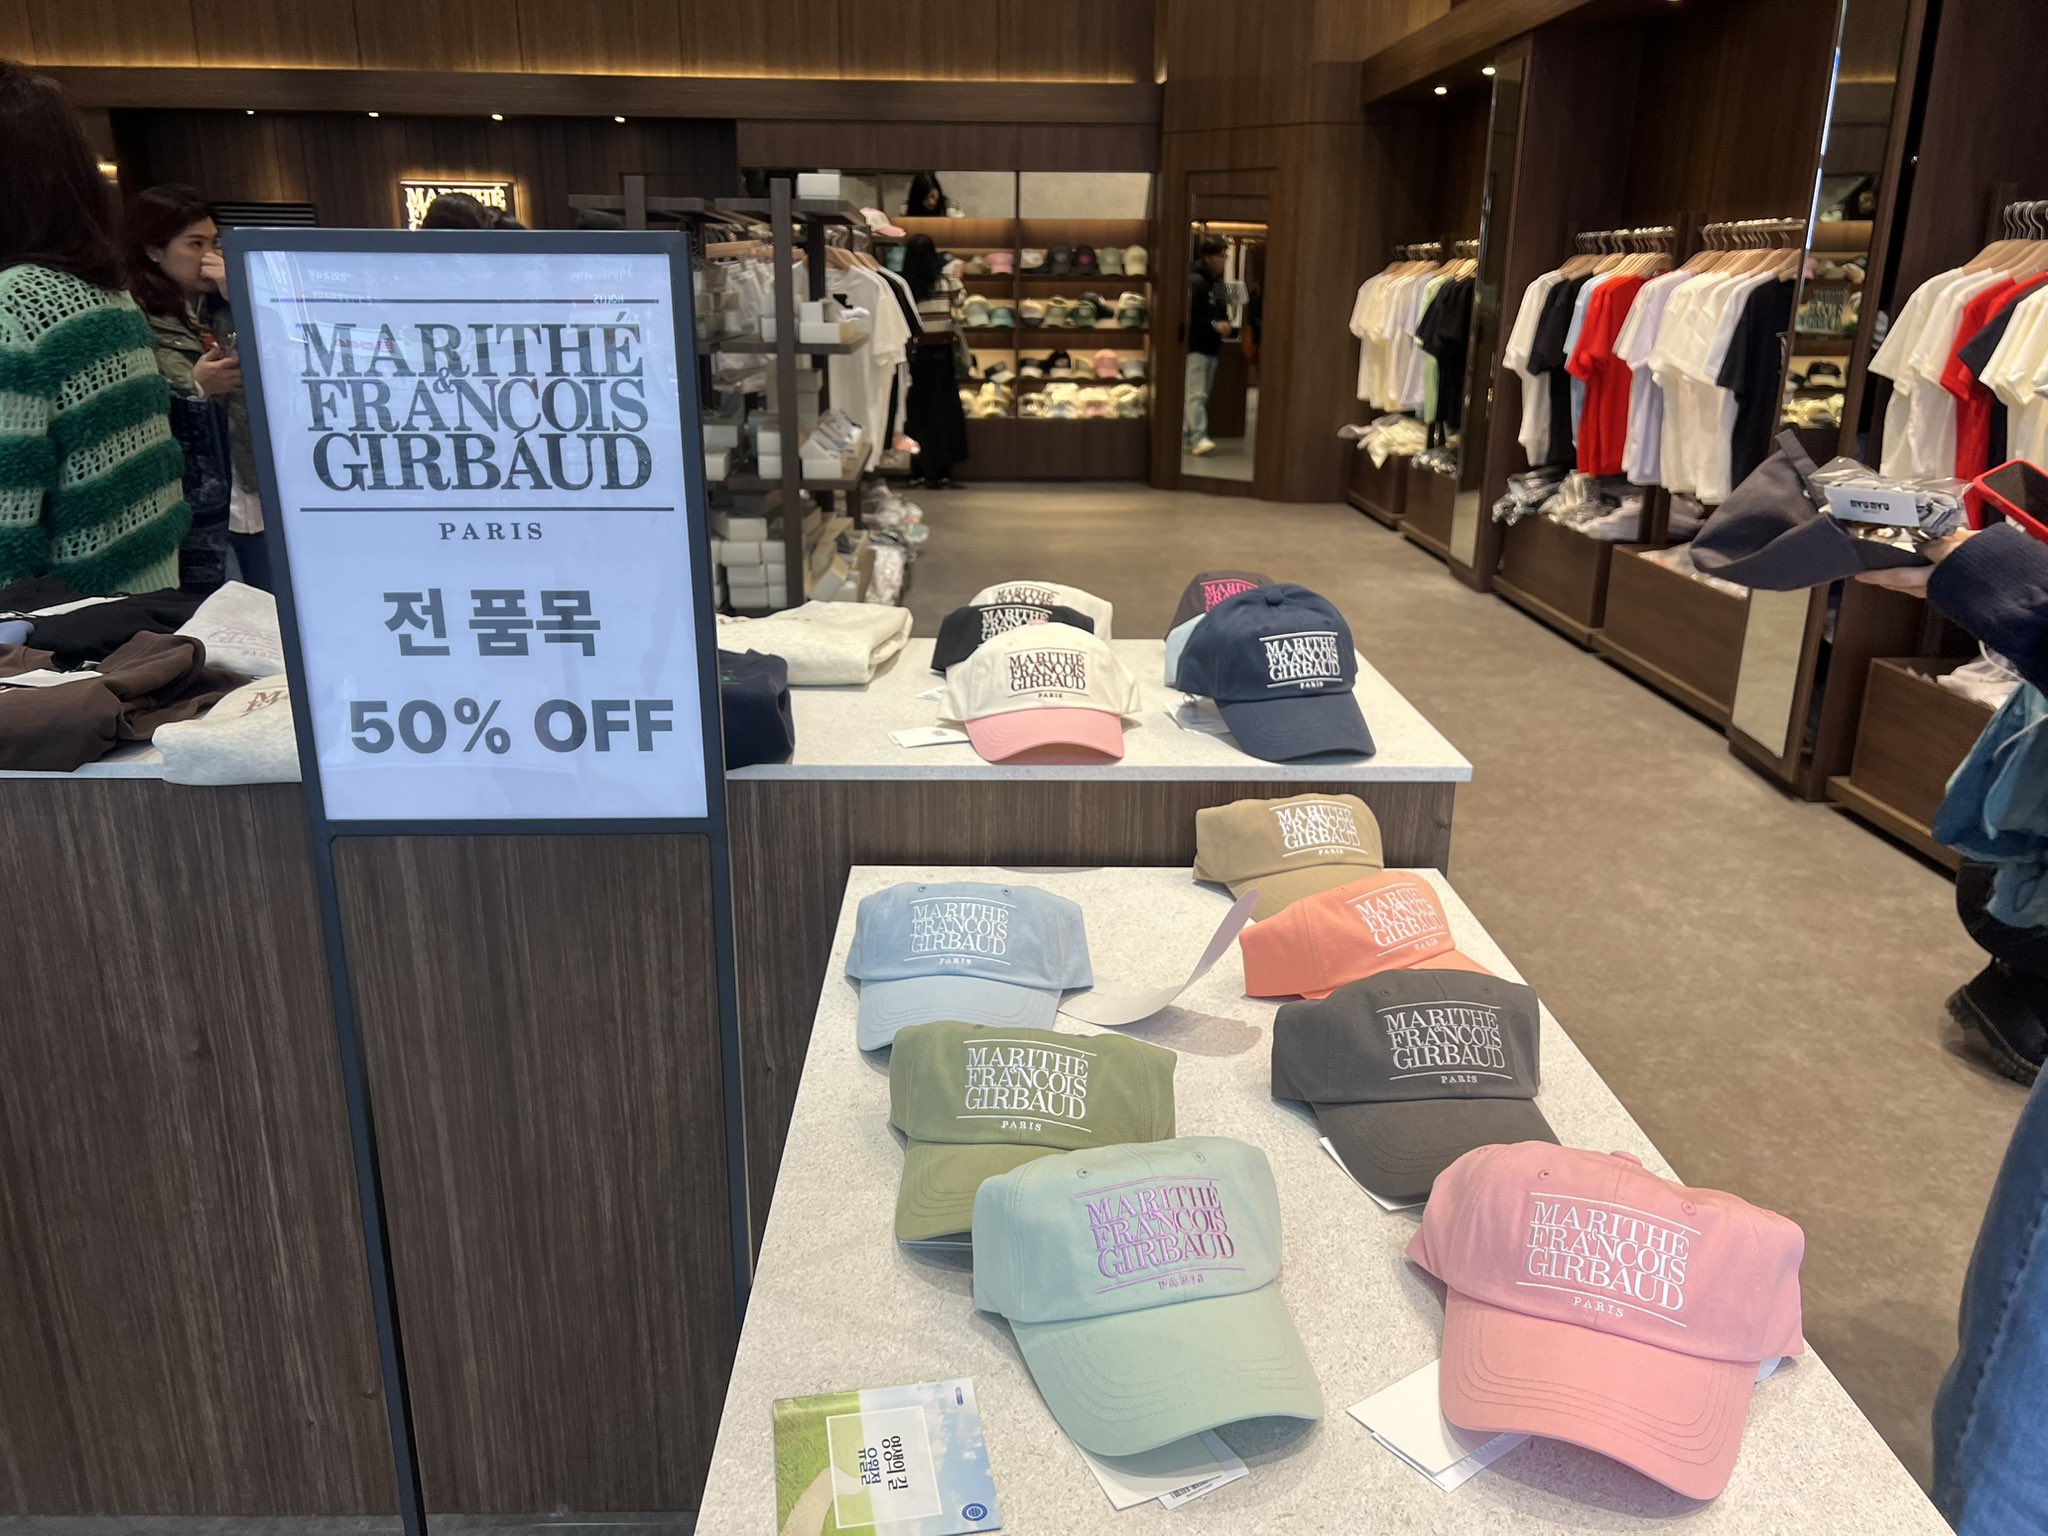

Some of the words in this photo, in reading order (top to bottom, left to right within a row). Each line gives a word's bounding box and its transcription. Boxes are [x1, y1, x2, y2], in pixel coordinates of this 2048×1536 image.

[296, 312, 643, 377] MARITHÉ
[312, 432, 652, 492] GIRBAUD
[438, 522, 544, 541] PARIS
[383, 588, 451, 657] 전
[468, 589, 601, 657] 품목
[1011, 674, 1086, 691] GIRBAUD
[1269, 661, 1340, 681] GIRBAUD
[349, 697, 511, 755] 50%
[534, 699, 674, 753] OFF
[911, 932, 1006, 955] GIRBAUD
[938, 957, 972, 965] PARIS
[966, 1047, 1089, 1079] MARITHÉ
[1392, 1044, 1506, 1070] GIRBAUD
[1440, 1075, 1478, 1084] PARIS
[964, 1087, 1087, 1120] GIRBAUD
[1001, 1120, 1042, 1132] PARIS
[1530, 1201, 1690, 1260] MARITHÉ
[1098, 1232, 1235, 1278] GIRBAUD
[1158, 1274, 1206, 1290] PARIS
[1527, 1248, 1684, 1311] GIRBAUD
[1572, 1296, 1625, 1318] PARIS
[858, 1447, 882, 1486] 유월절
[881, 1435, 906, 1474] 영생의
[888, 1476, 909, 1491] 길
